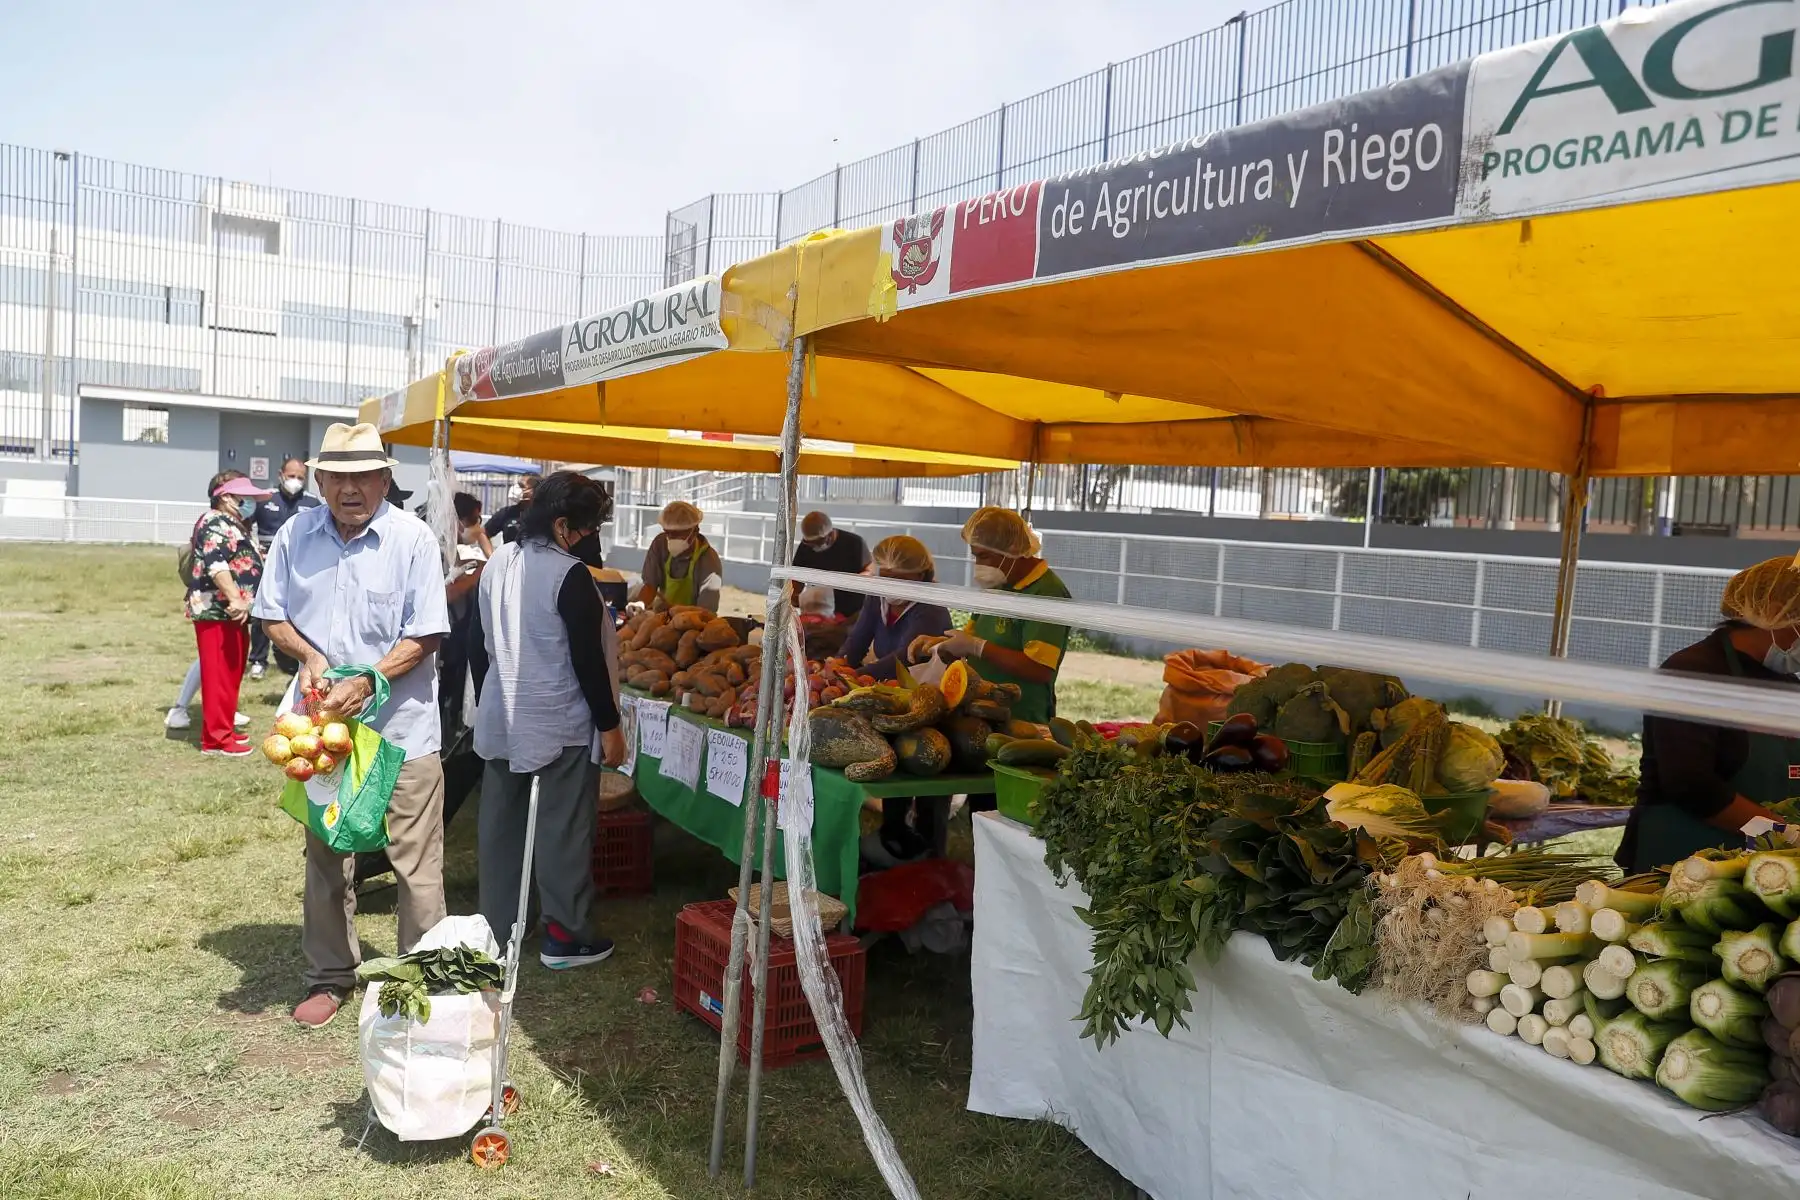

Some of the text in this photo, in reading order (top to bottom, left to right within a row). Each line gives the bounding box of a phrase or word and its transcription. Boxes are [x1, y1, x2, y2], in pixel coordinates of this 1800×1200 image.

[1481, 102, 1782, 181] PROGRAMA DE
[1051, 188, 1085, 239] de
[1091, 157, 1274, 239] Agricultura
[1287, 148, 1309, 209] y
[1322, 122, 1444, 192] Riego
[492, 348, 560, 384] de Agricultura y Riego
[565, 356, 592, 373] PROGRAMA
[599, 347, 631, 365] DESARROLLO
[631, 336, 668, 357] PRODUCTIVO
[669, 327, 699, 348] AGRARIO
